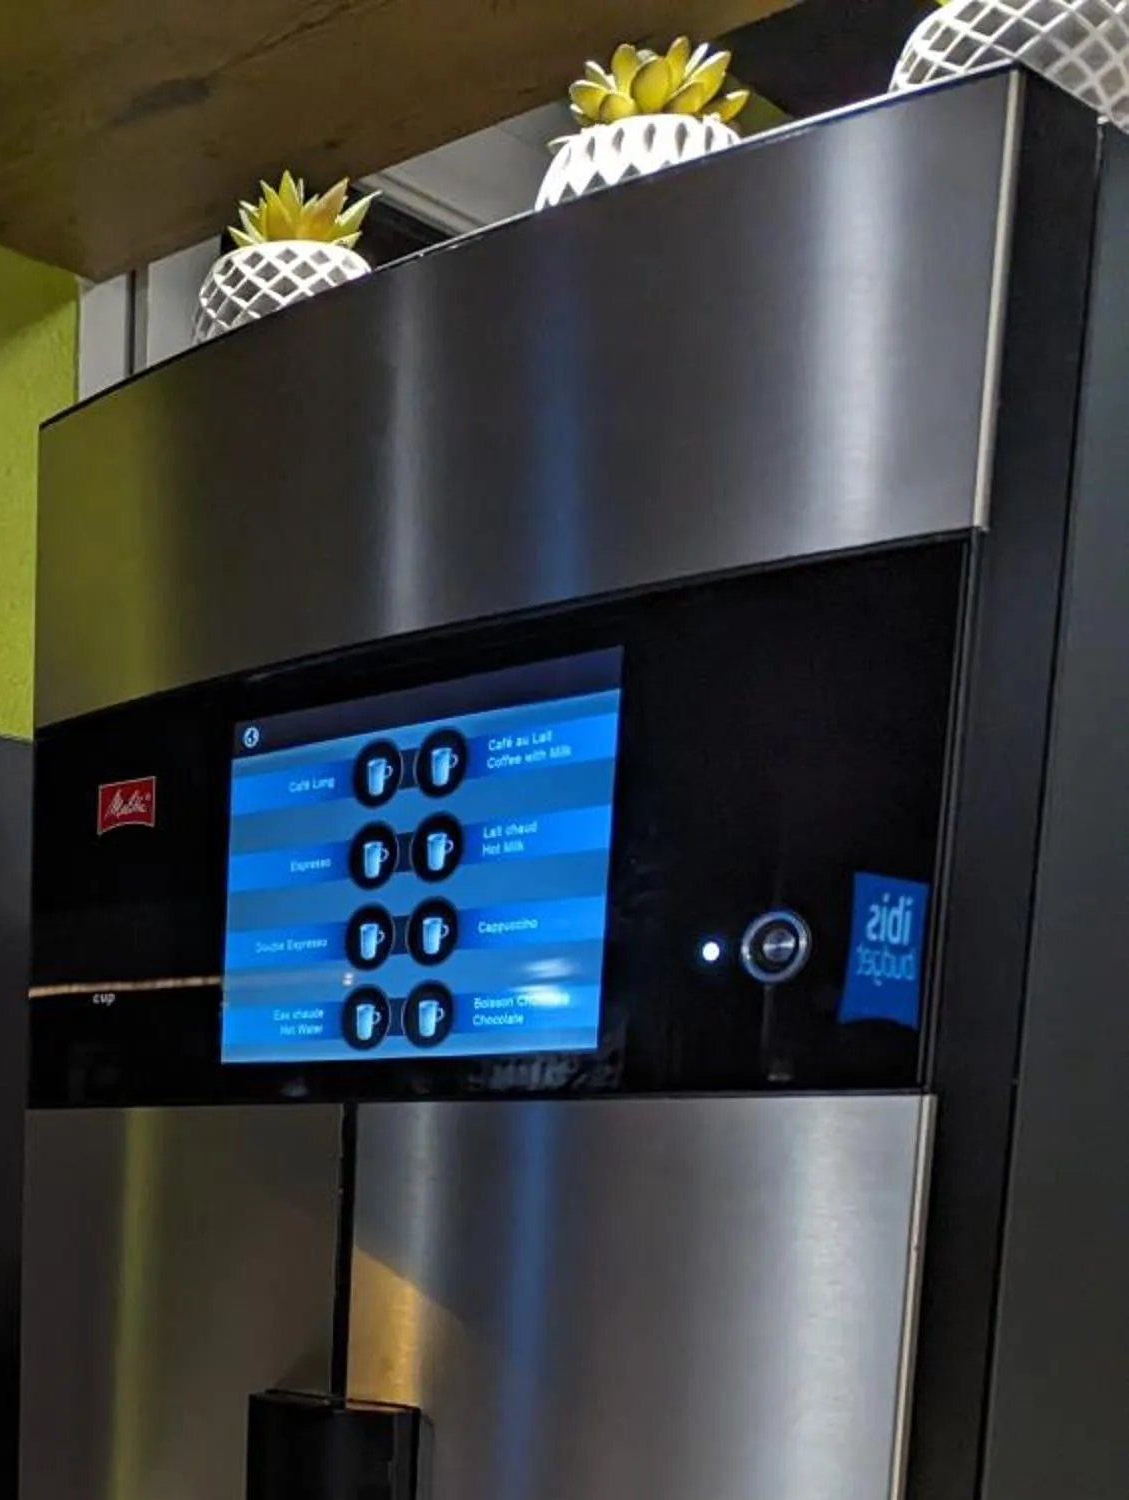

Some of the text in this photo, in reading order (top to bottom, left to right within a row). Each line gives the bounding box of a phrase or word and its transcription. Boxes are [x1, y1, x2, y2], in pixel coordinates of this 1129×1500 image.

[488, 730, 552, 751] Café au Lait
[486, 745, 572, 769] Coffee with Milk
[482, 820, 538, 839] Lait chaud
[482, 841, 525, 856] Hot Milk
[290, 858, 331, 872] Espresso
[477, 919, 538, 934] Cappuccino
[92, 993, 116, 1006] cup
[473, 997, 513, 1010] Boisson
[472, 1013, 524, 1027] Chocolate
